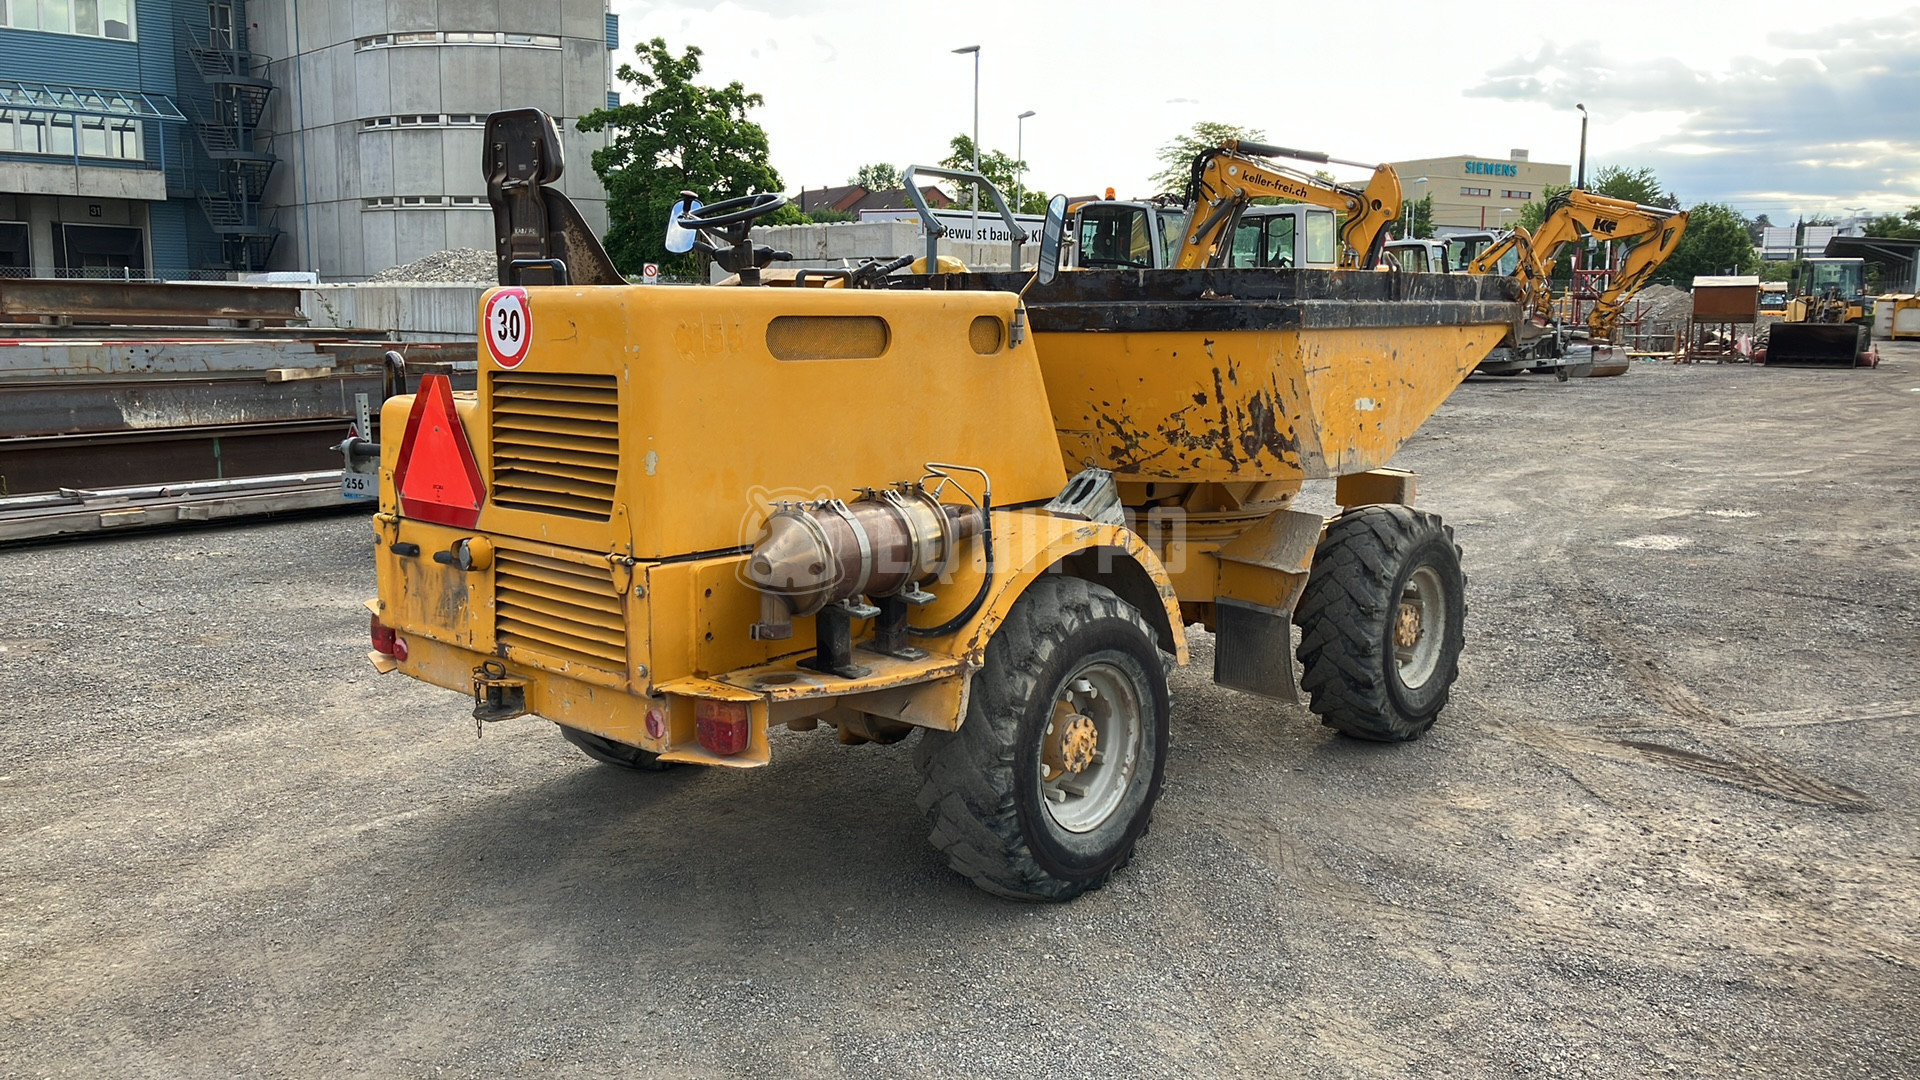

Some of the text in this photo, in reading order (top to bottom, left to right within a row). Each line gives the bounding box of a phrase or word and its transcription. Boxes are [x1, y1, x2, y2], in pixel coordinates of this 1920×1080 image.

[1465, 161, 1517, 177] SIEMENS
[1242, 170, 1307, 198] keller-frei.ch
[90, 206, 101, 216] 31
[943, 225, 986, 240] Bewust
[1593, 217, 1618, 233] KF
[498, 308, 520, 342] 30
[345, 477, 364, 490] 256
